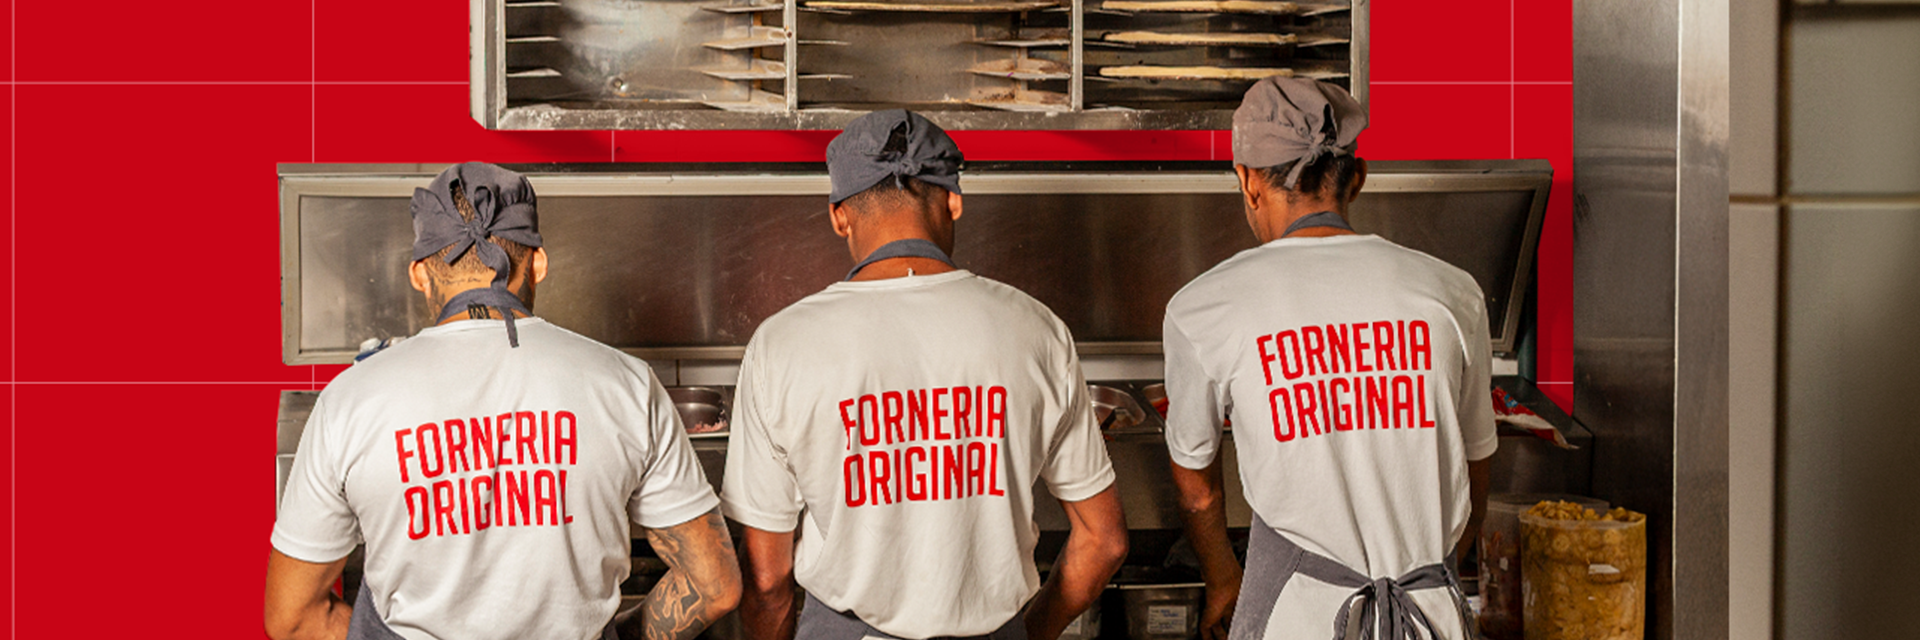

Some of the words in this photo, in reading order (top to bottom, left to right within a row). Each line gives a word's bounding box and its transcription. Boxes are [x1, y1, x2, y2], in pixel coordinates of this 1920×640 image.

[1257, 320, 1432, 386] FORNERIA
[839, 385, 1008, 451] FORNERIA
[1269, 375, 1436, 443] ORIGINAL
[395, 410, 577, 484] FORNERIA
[844, 442, 1005, 508] ORIGINAL
[404, 469, 574, 541] ORIGINAL
